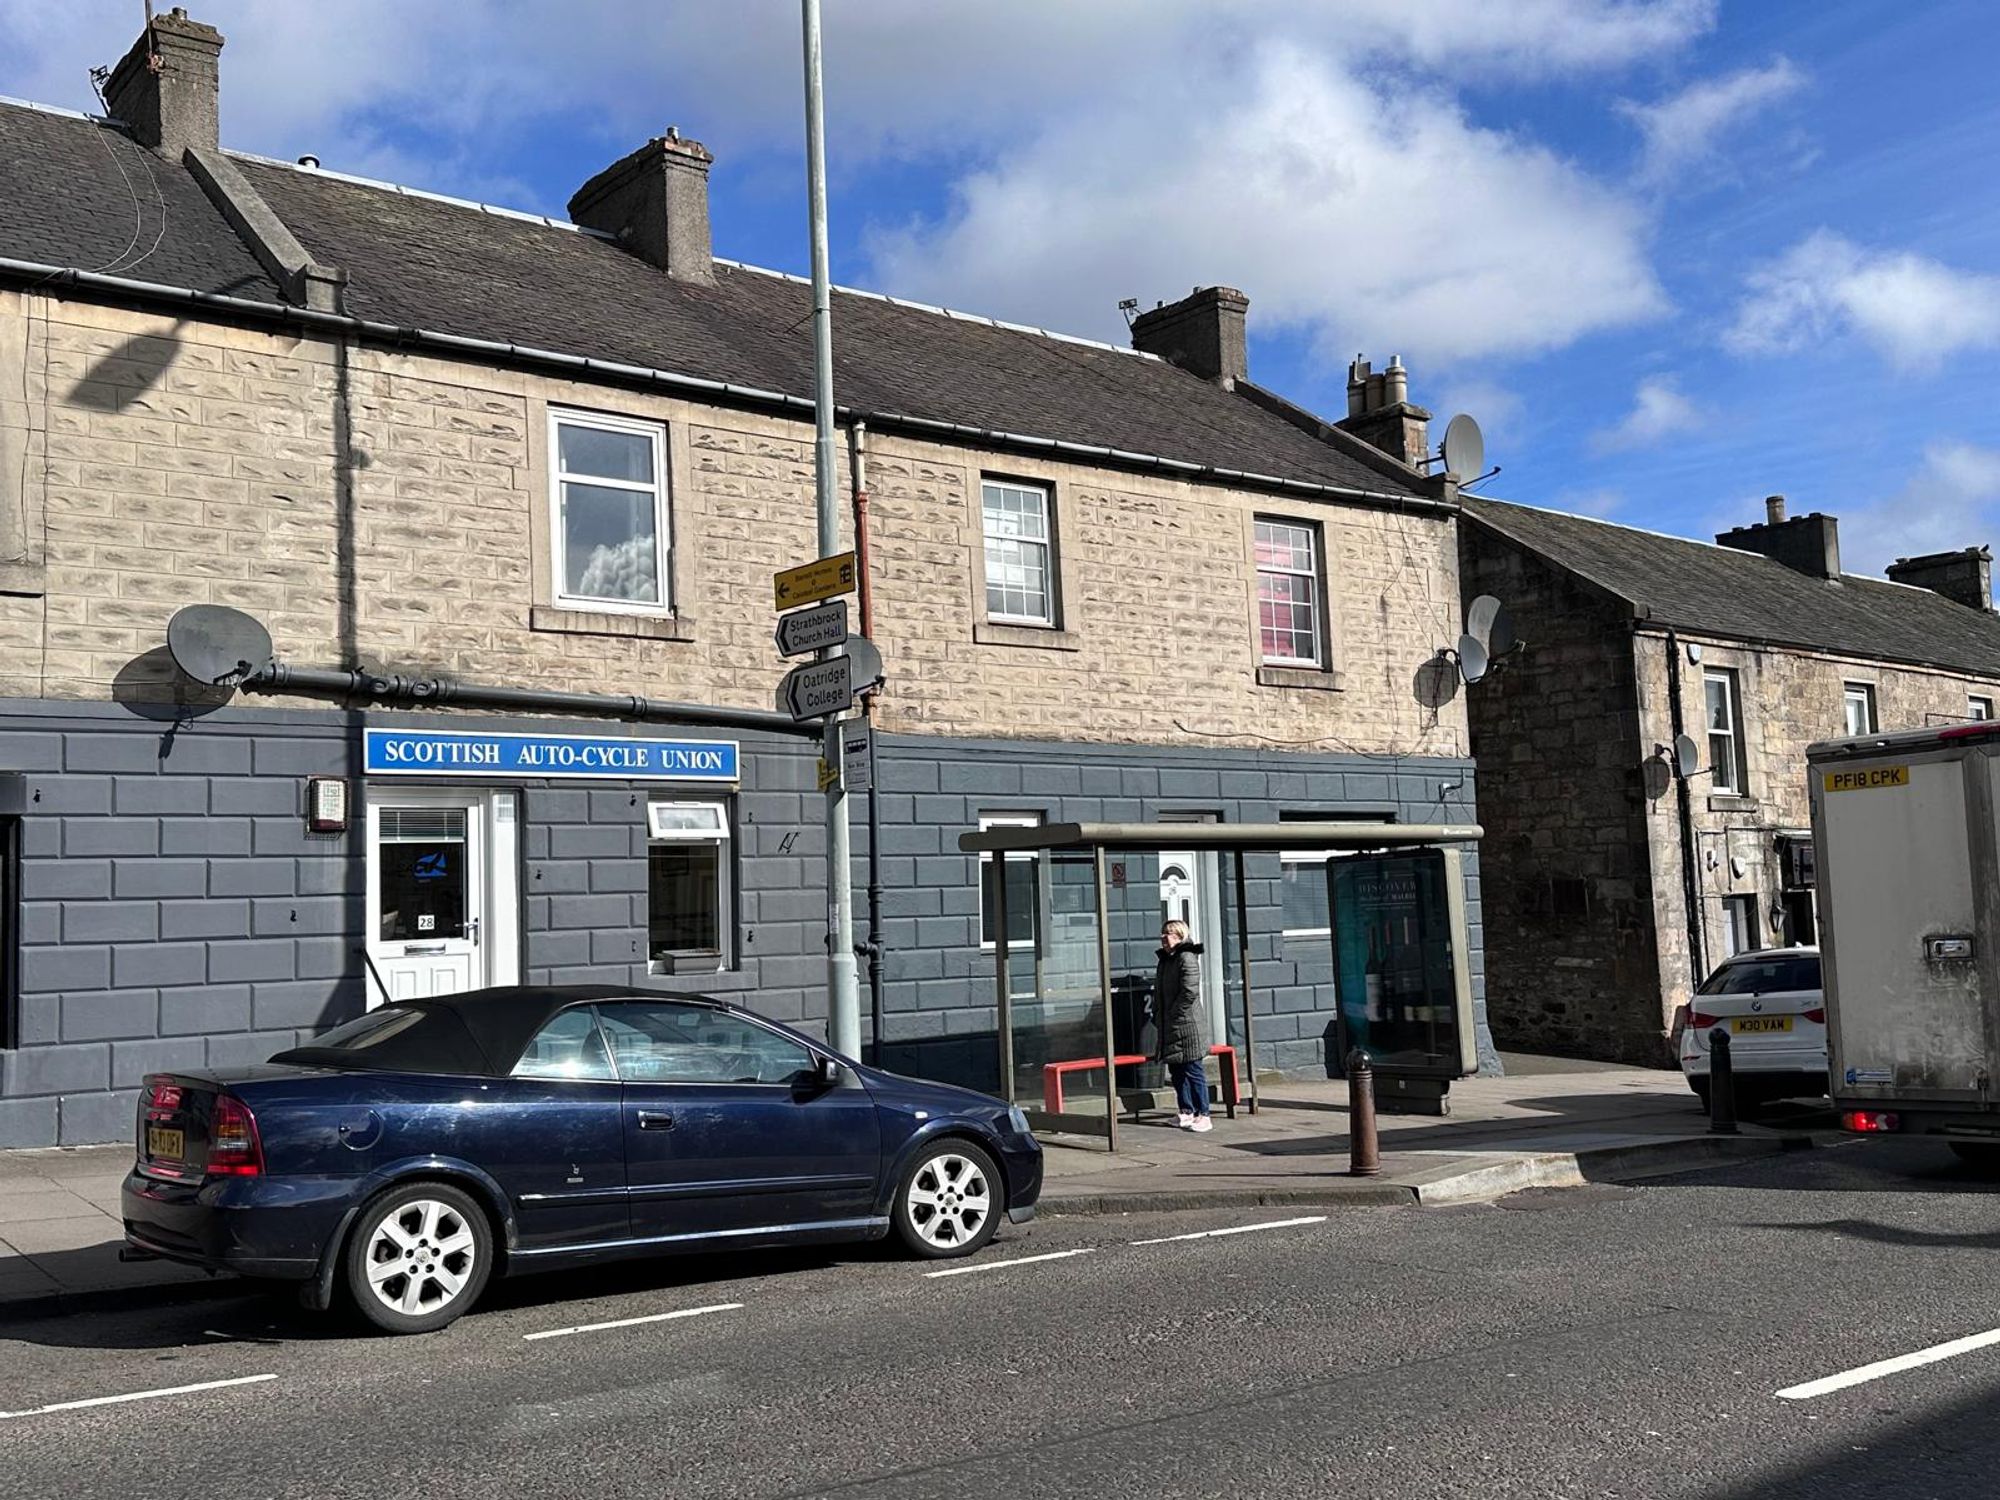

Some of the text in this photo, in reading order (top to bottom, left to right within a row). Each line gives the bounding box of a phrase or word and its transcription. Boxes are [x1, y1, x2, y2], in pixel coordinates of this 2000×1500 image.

[790, 610, 841, 632] Strathbrock
[792, 624, 841, 647] Church Hall
[803, 667, 846, 689] Oatridge
[807, 689, 844, 707] College
[385, 740, 723, 769] SCOTTISH AUTO-CYCLE UNION
[1834, 768, 1901, 788] PF18 CPK
[420, 917, 434, 928] 28
